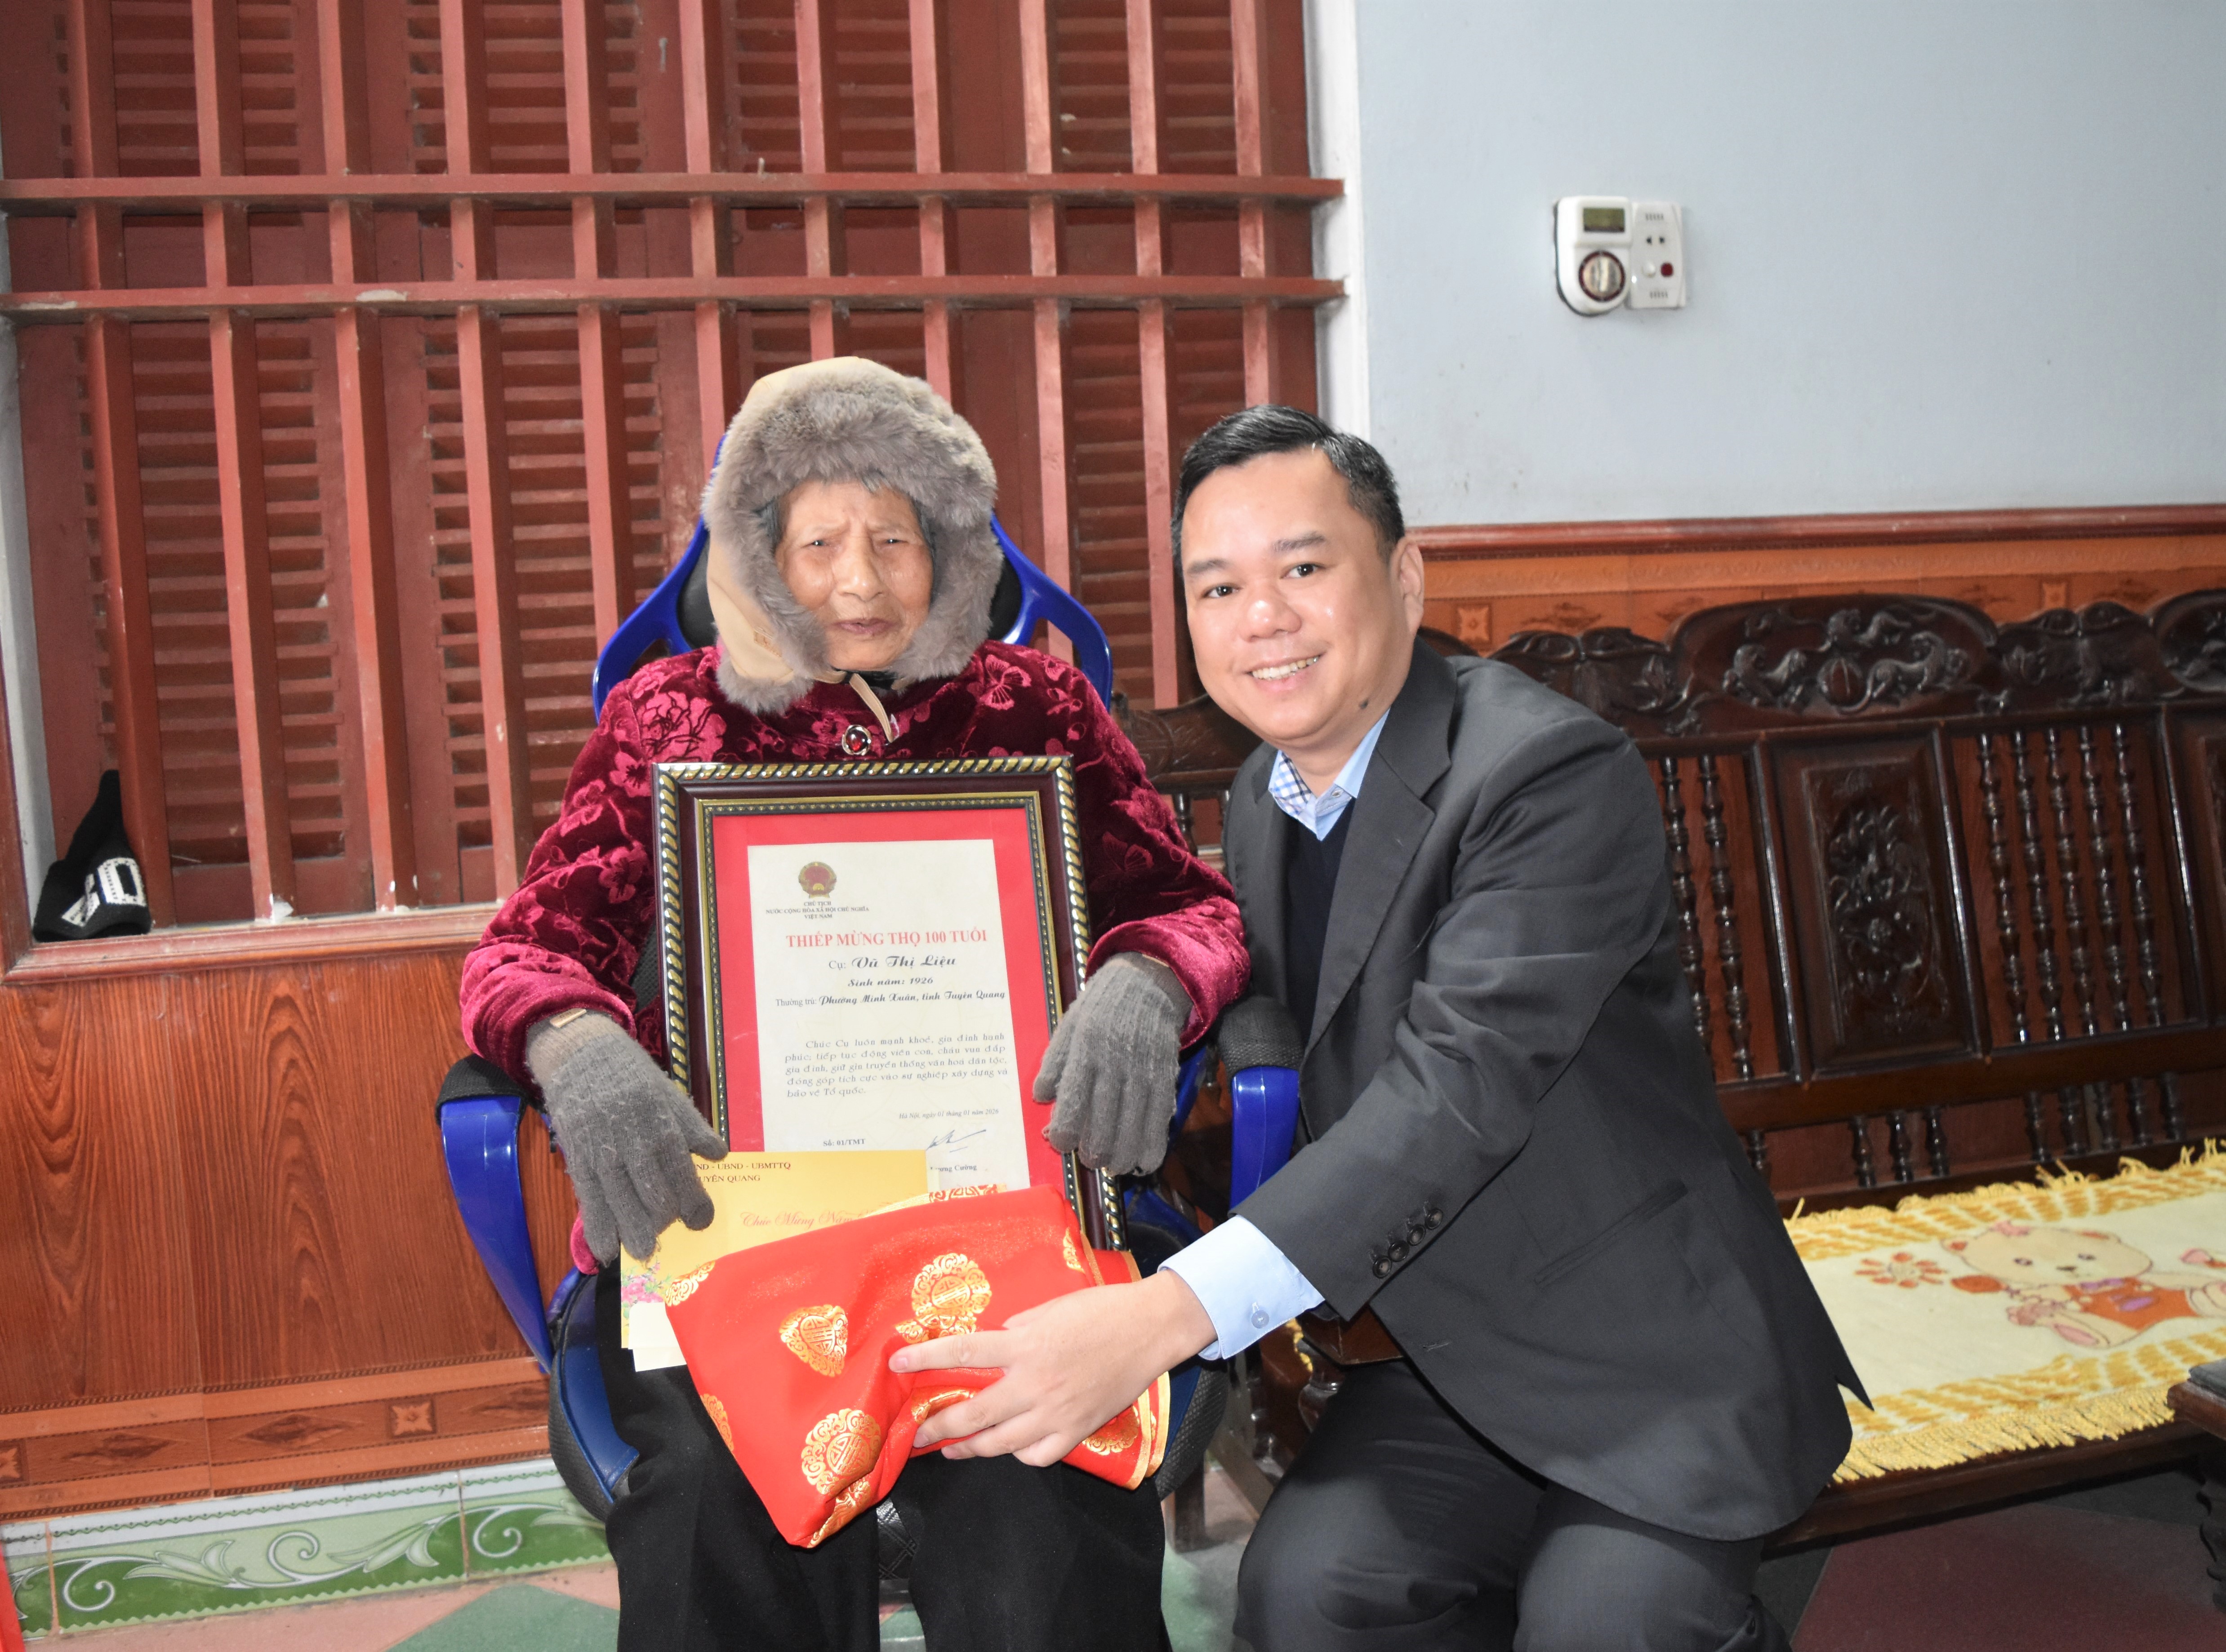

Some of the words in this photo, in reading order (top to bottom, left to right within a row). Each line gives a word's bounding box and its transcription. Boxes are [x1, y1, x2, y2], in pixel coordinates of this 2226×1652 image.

[786, 931, 833, 948] THIẾP
[837, 930, 884, 946] MỪNG
[887, 931, 921, 947] THỌ
[925, 931, 947, 943] 100
[950, 926, 987, 942] TUỔI
[828, 960, 846, 971] Cụ:
[851, 956, 879, 968] Vũ
[885, 955, 915, 969] Thị
[920, 955, 957, 968] Liệu
[848, 978, 873, 987] Sinh
[909, 977, 934, 985] 1926
[776, 998, 803, 1007] Thường
[819, 995, 857, 1006] Phường
[860, 994, 886, 1003] Minh
[944, 991, 972, 1000] Tuyên
[976, 990, 1005, 1000] Quang
[806, 1040, 831, 1048] Chúc
[880, 1037, 904, 1045] mạnh
[938, 1035, 952, 1044] gia
[983, 1033, 1005, 1041] hạnh
[816, 1052, 837, 1061] tiếp
[861, 1051, 887, 1059] động
[785, 1066, 800, 1075] gia
[831, 1065, 846, 1074] giữ
[899, 1060, 926, 1070] thống
[787, 1077, 813, 1087] đóng
[816, 1077, 835, 1087] góp
[839, 1075, 856, 1083] tích
[917, 1071, 948, 1081] nghiệp
[952, 1070, 968, 1079] xây
[971, 1069, 994, 1078] dựng
[824, 1087, 836, 1096] Tổ
[699, 1174, 724, 1183] UYÊN
[727, 1175, 761, 1183] QUANG
[740, 1212, 772, 1227] Chúc
[775, 1210, 815, 1229] Mừng
